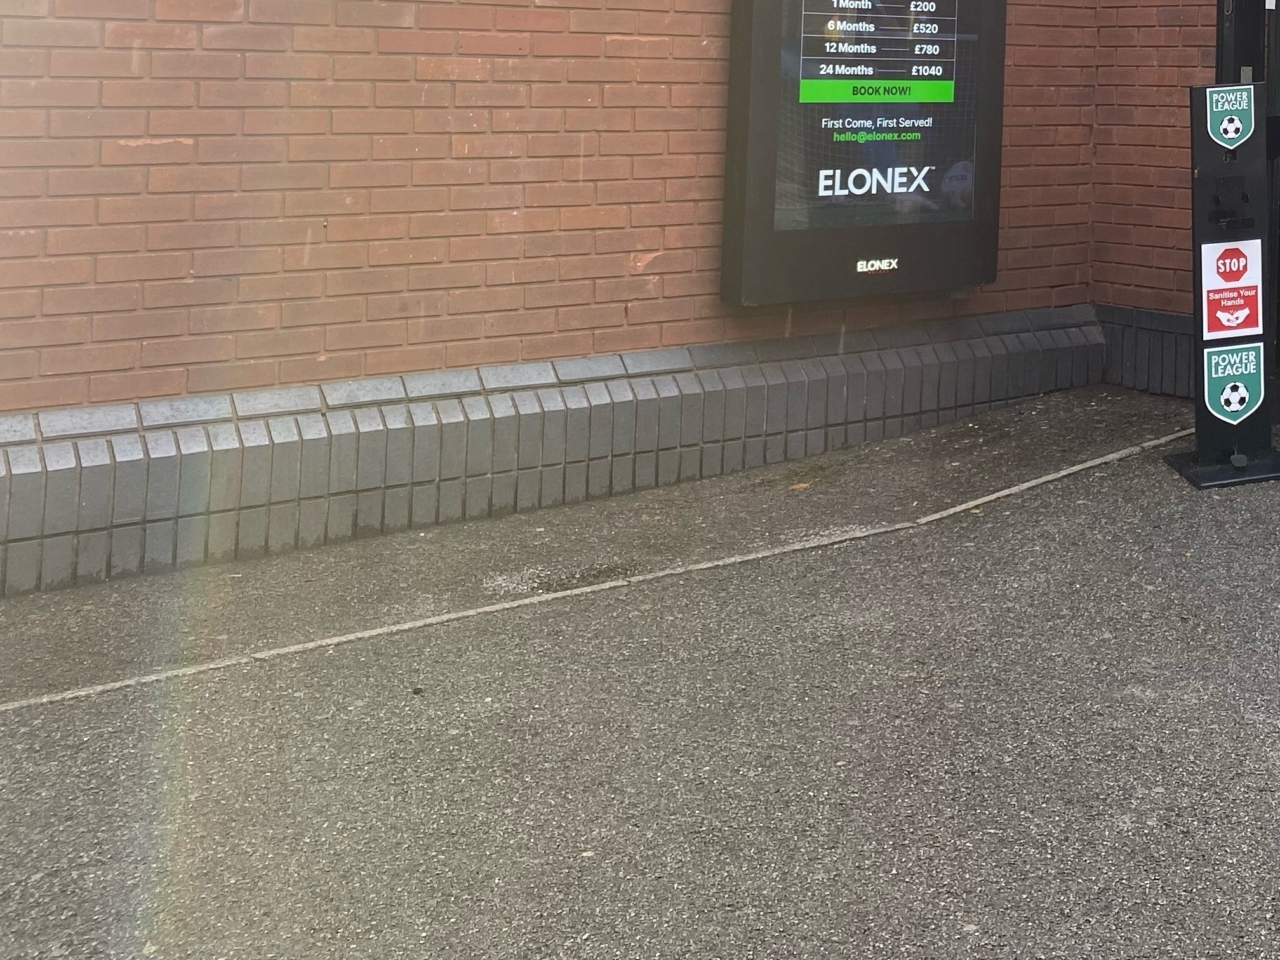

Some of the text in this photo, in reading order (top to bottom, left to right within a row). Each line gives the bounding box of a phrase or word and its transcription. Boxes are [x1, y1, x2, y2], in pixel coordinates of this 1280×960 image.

[909, 1, 936, 12] £200
[827, 20, 939, 34] 6 Months £520
[824, 42, 940, 55] 12 Months £780
[819, 64, 943, 76] 24 Months £1040
[852, 86, 911, 96] BOOK NOW!
[1212, 91, 1249, 102] POWER
[1212, 100, 1249, 112] LEAGUE
[821, 117, 933, 130] First Come, First Served!
[833, 131, 921, 143] hello@elonex.com
[857, 258, 899, 273] ELONEX
[1217, 256, 1247, 273] STOP
[1208, 288, 1257, 300] Sanitise Your
[1220, 298, 1245, 307] Hands
[1211, 351, 1256, 367] POWER
[1211, 361, 1257, 378] LEAGUE
